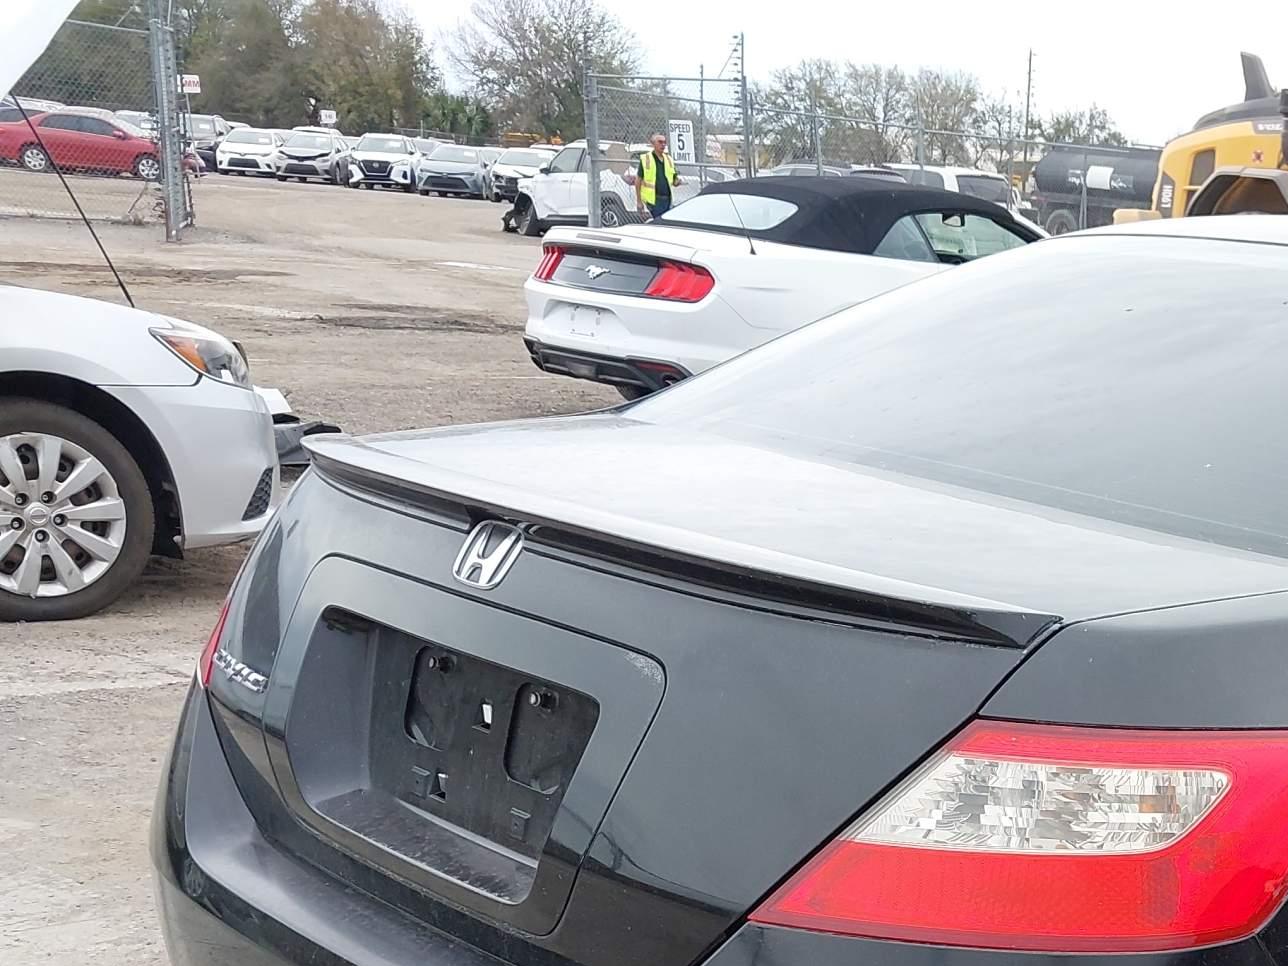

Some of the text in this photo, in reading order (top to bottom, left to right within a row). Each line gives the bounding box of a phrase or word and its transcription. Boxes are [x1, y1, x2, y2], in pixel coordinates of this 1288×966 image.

[670, 123, 690, 133] SPEED
[677, 133, 685, 151] 5
[673, 152, 691, 161] LIMIT
